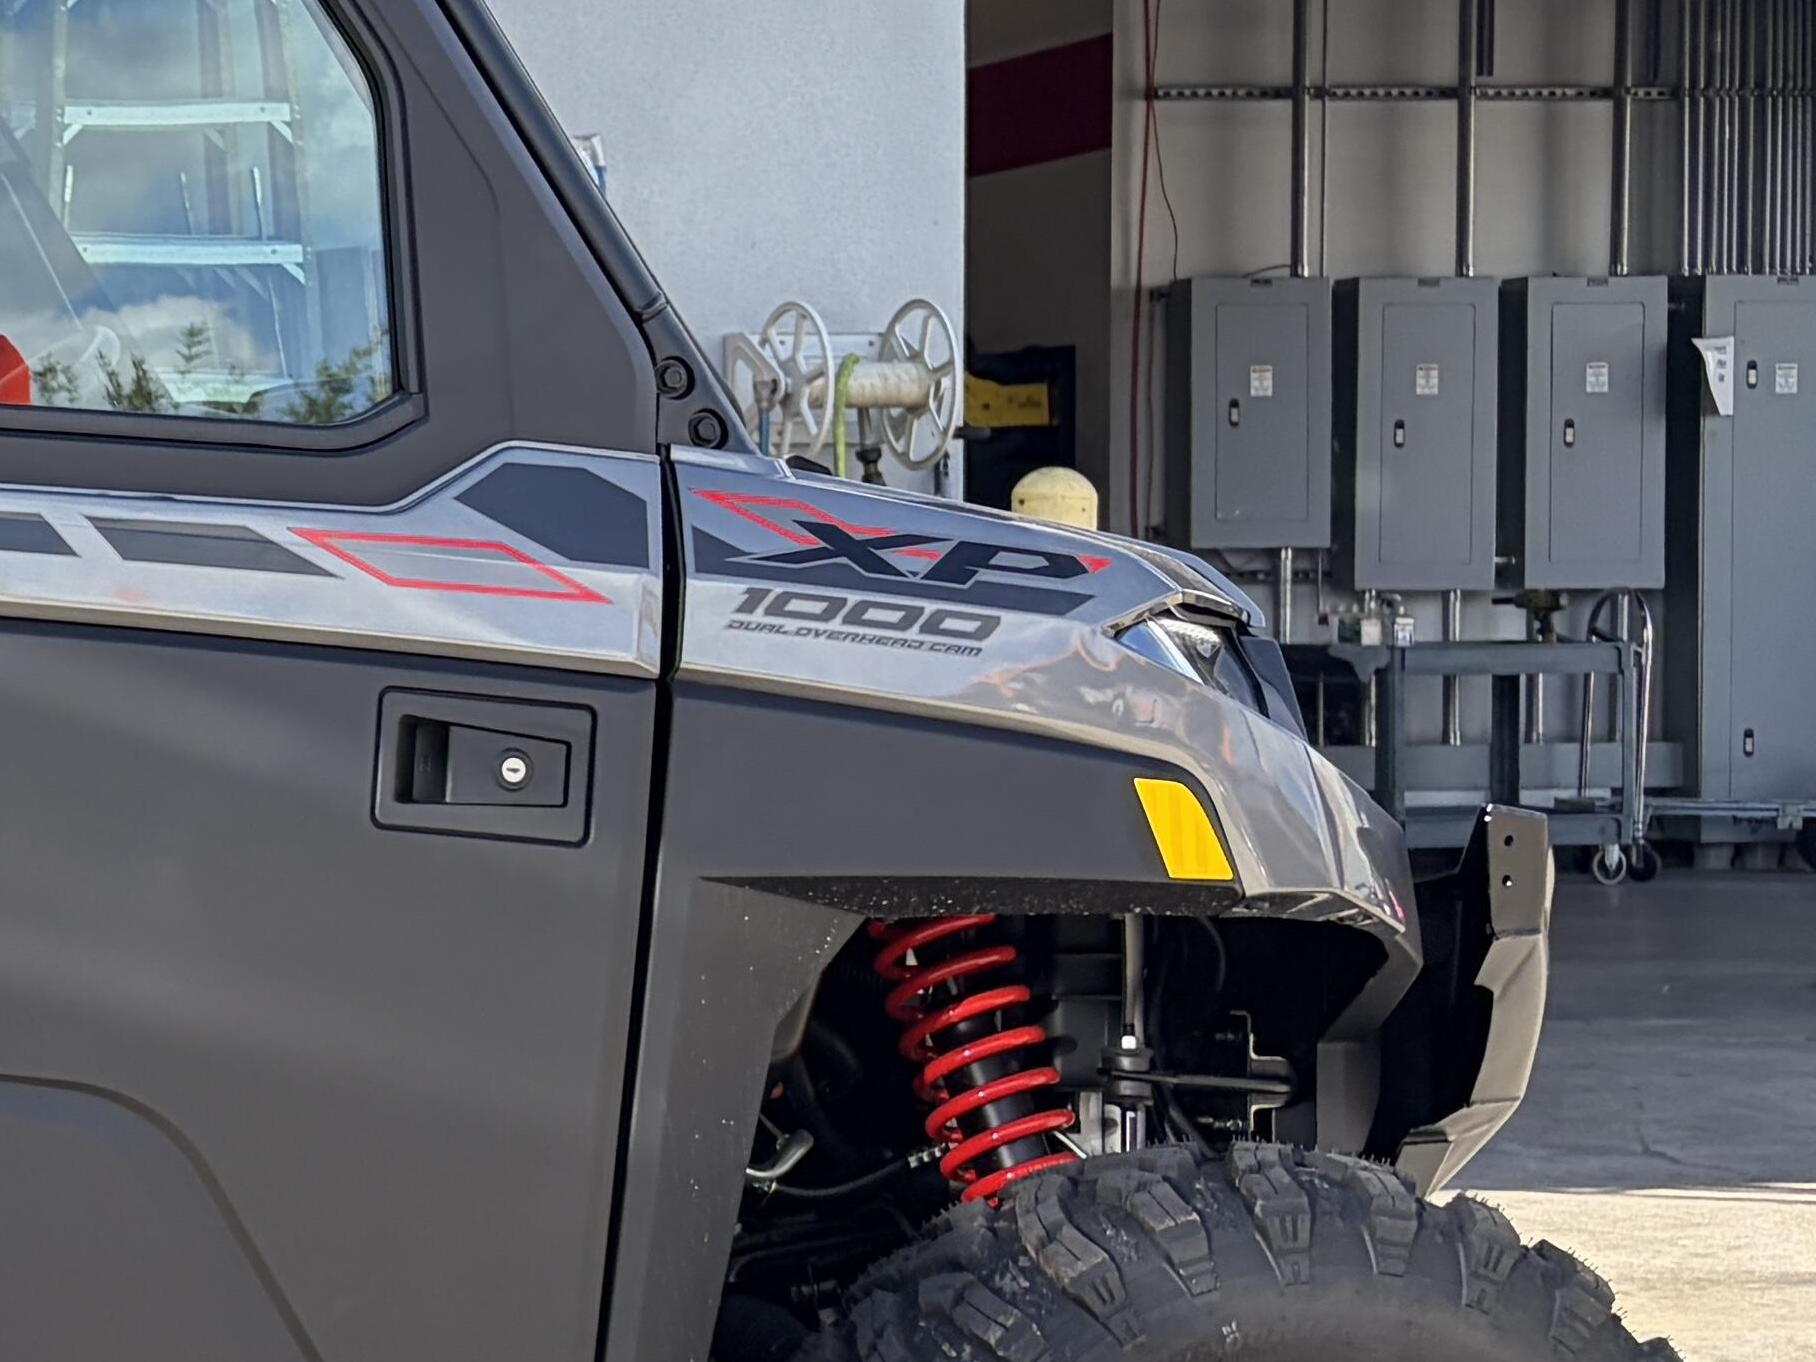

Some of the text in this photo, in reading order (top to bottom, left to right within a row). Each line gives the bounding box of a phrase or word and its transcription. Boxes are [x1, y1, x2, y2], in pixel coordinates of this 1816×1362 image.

[743, 519, 1092, 585] XP
[726, 619, 983, 657] DUAL OVERHEAD CAM
[733, 587, 1001, 642] 1000
